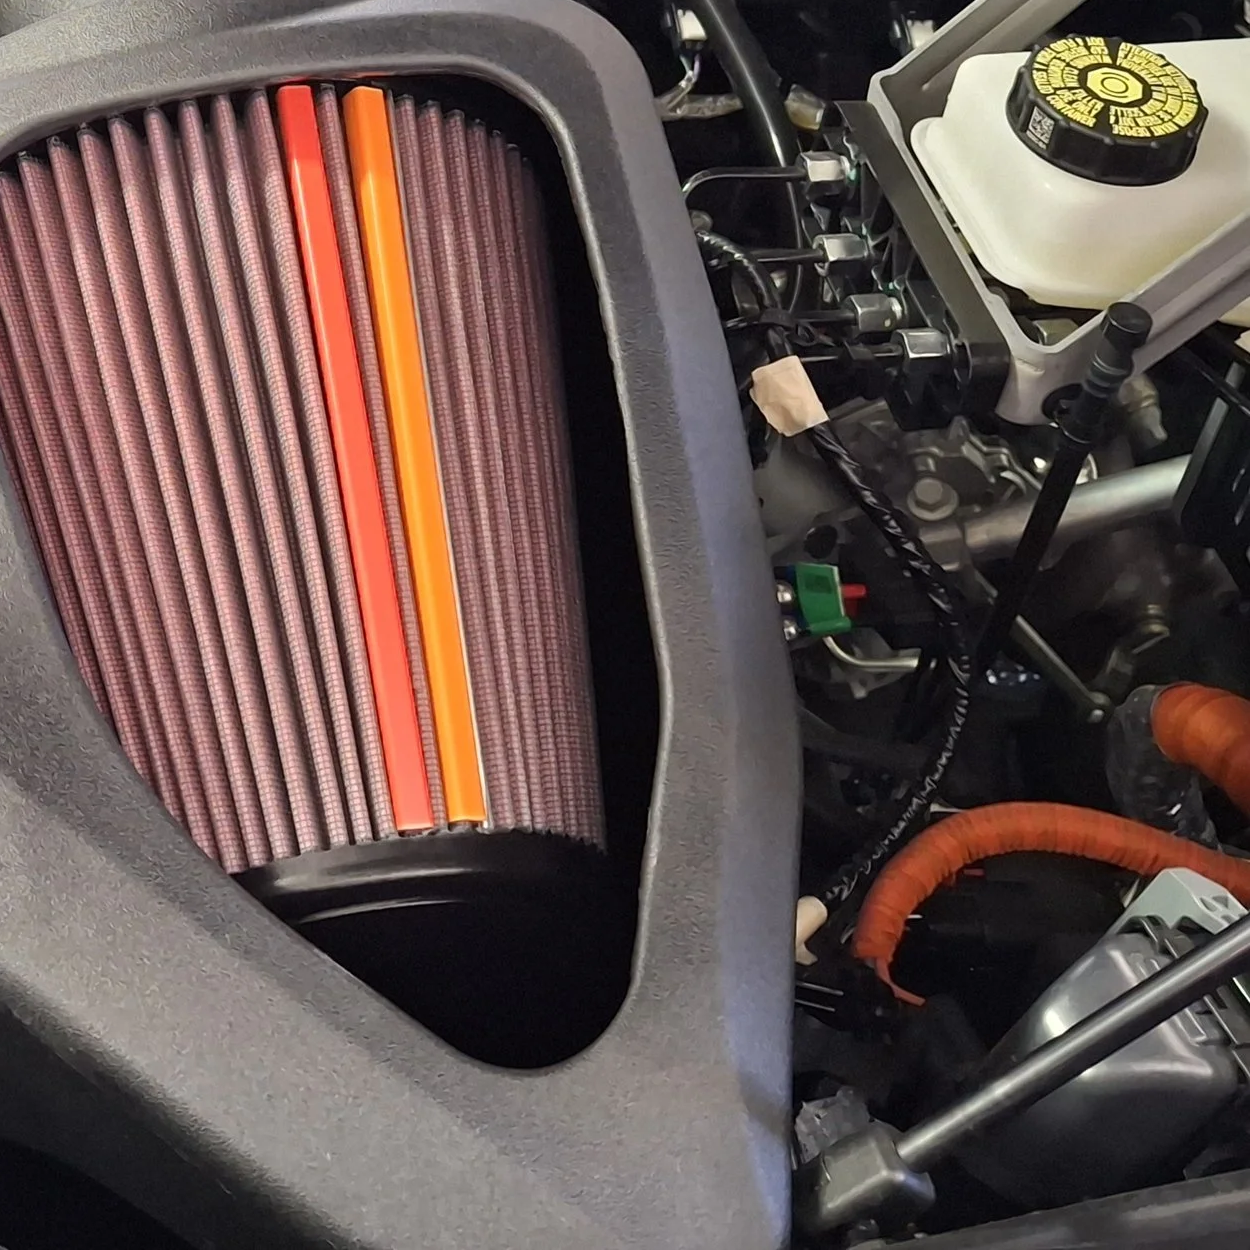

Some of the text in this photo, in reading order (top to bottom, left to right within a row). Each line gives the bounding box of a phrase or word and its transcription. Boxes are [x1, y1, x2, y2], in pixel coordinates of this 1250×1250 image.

[1050, 39, 1077, 52] FLUID
[1086, 37, 1105, 46] DOT
[1090, 46, 1108, 55] CAP
[1056, 89, 1076, 102] USE
[1070, 89, 1104, 111] FILLER
[1046, 95, 1095, 126] CONTAINER
[1072, 101, 1098, 117] ONLY
